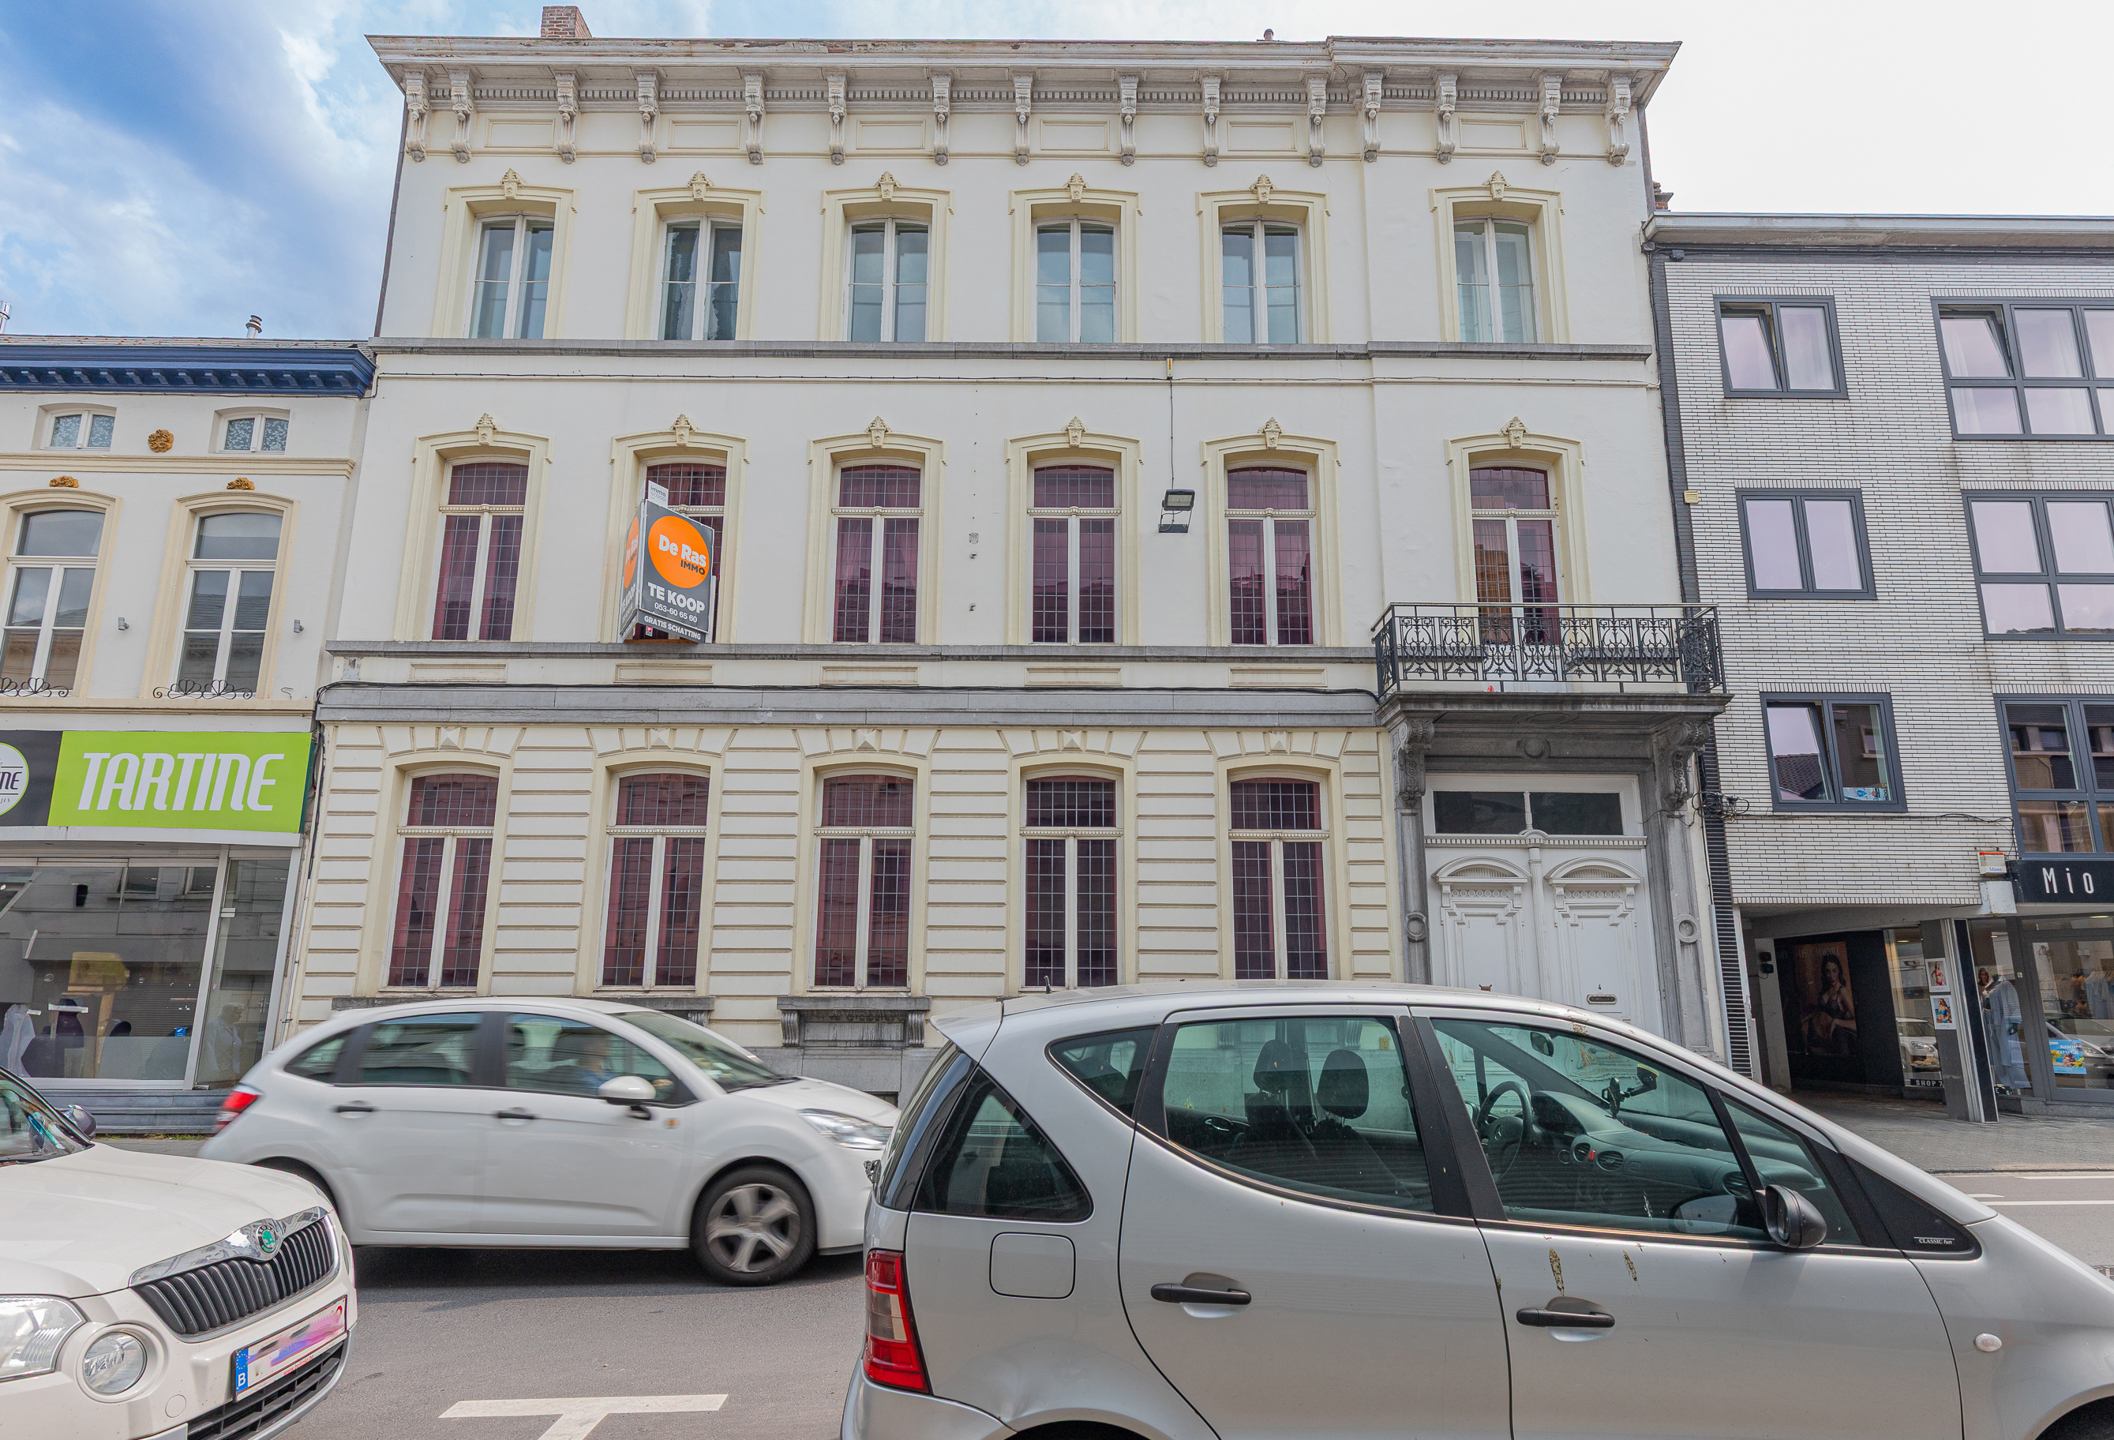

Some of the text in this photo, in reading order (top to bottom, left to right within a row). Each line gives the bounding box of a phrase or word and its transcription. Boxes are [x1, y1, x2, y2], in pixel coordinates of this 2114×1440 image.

[659, 534, 707, 567] De Ras
[680, 560, 705, 575] IMMO
[648, 581, 705, 613] TE KOOP
[654, 602, 698, 623] 053-60 65 60
[643, 615, 667, 629] GRATIS
[667, 623, 702, 640] SCHATTING
[78, 752, 285, 811] TARTINE
[2042, 867, 2095, 894] Mio
[238, 1372, 247, 1388] B
